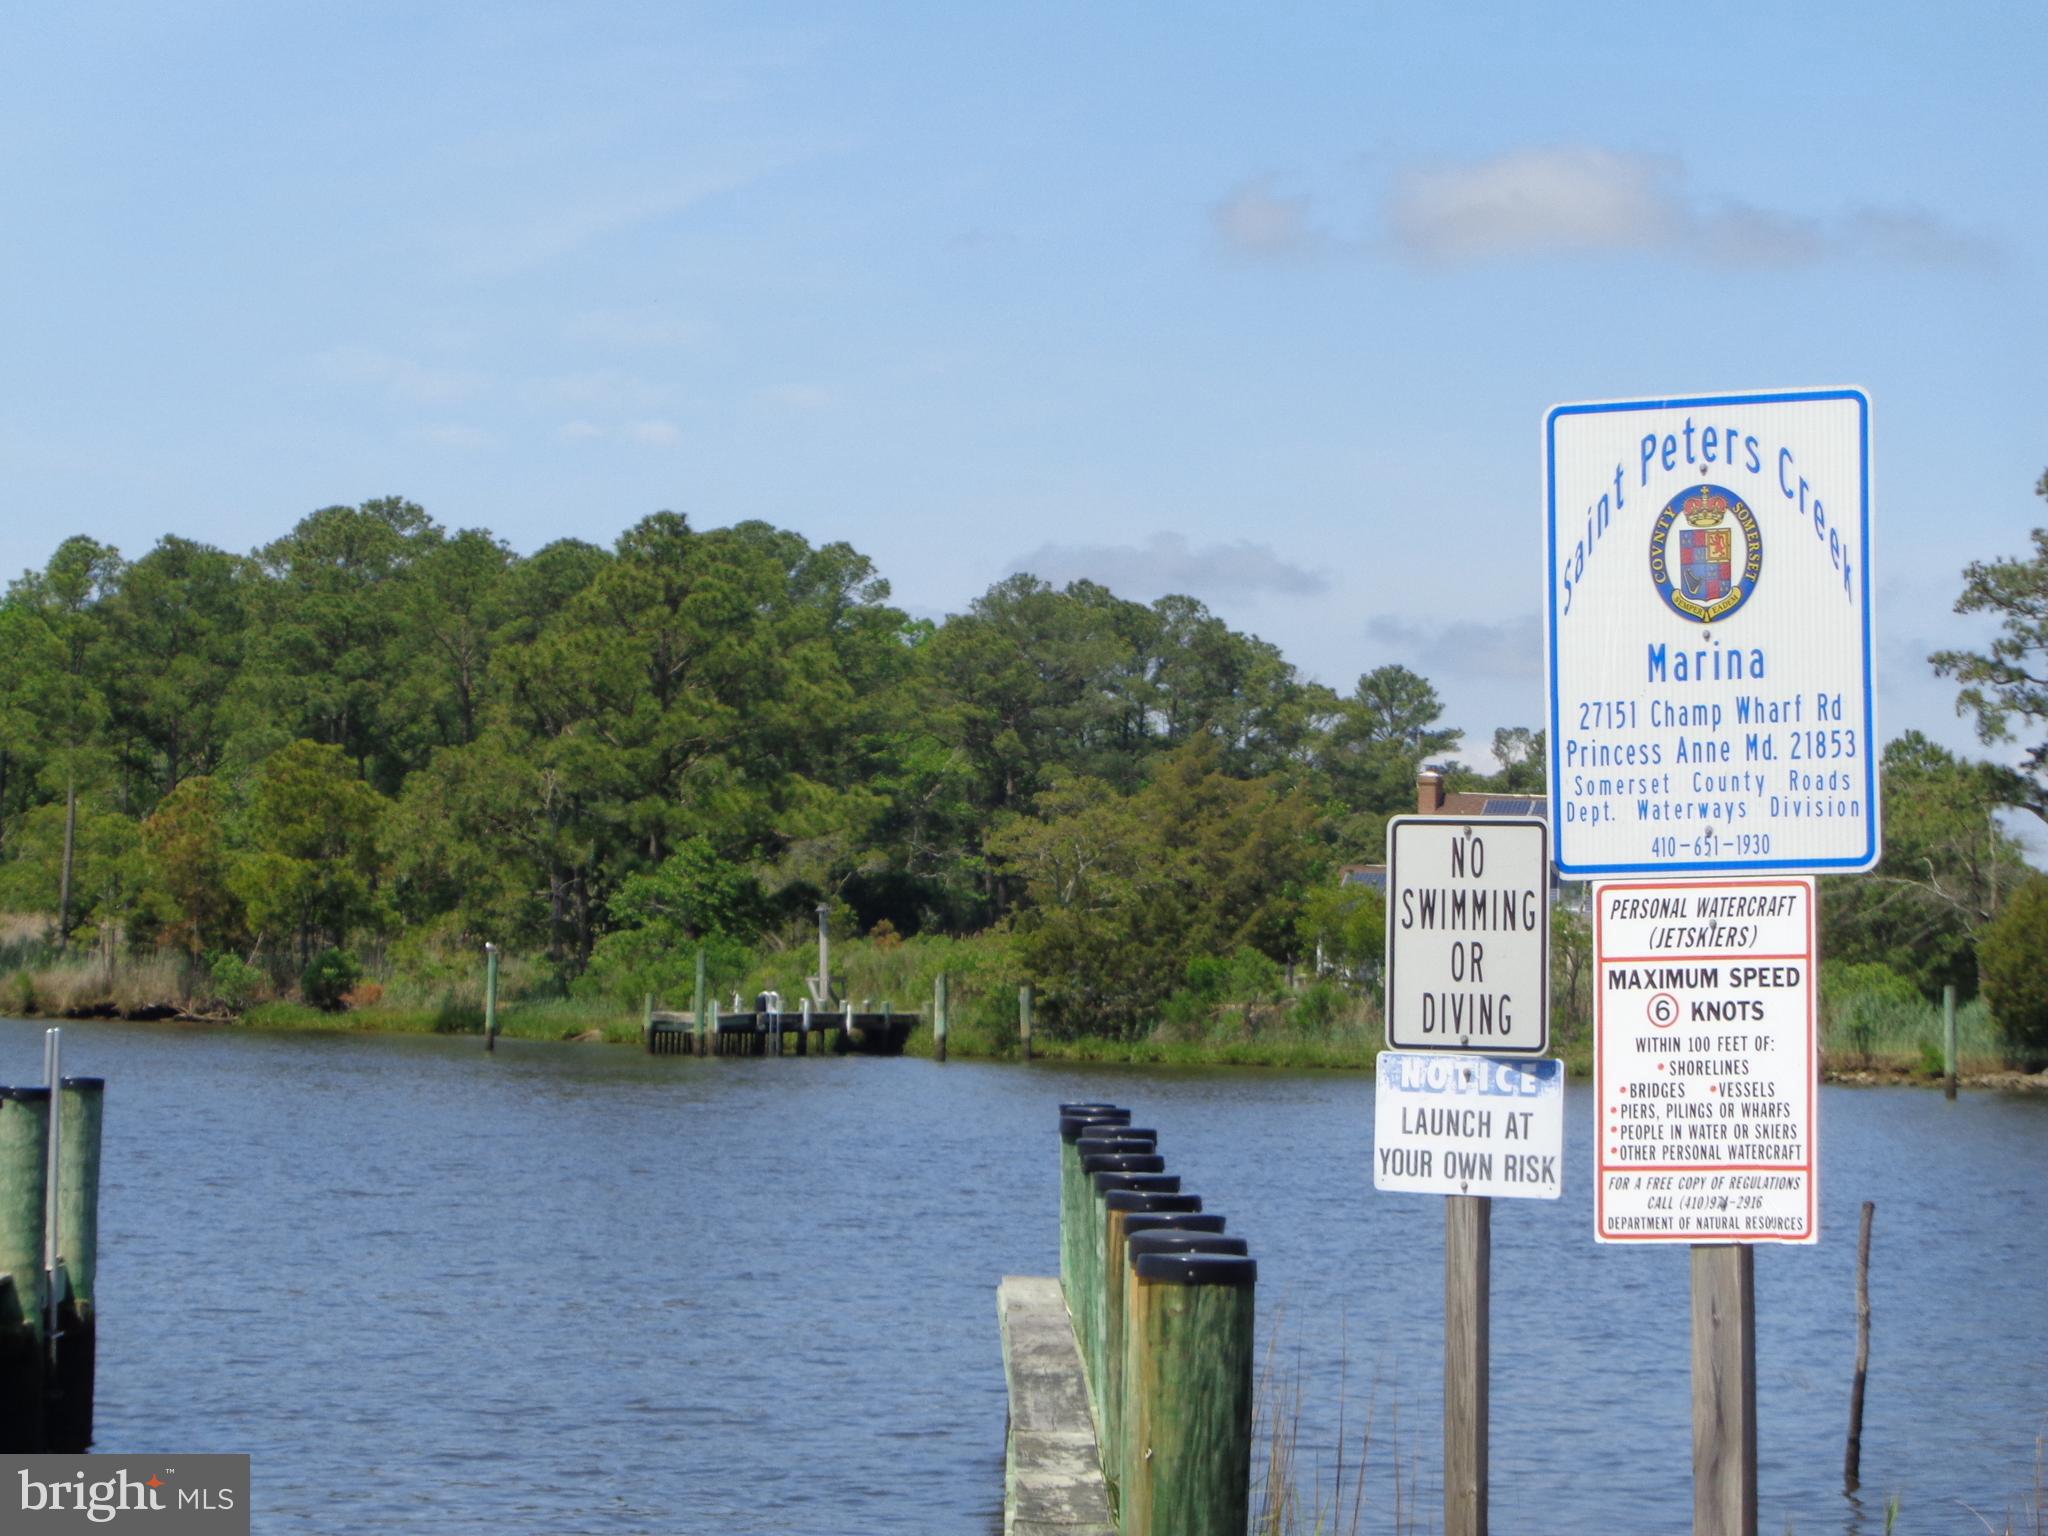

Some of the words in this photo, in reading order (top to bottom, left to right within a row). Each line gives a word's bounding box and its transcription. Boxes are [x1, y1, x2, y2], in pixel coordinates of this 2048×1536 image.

[1563, 461, 1625, 616] Saint
[1641, 416, 1761, 487] Peters
[1778, 447, 1852, 605] Creek
[1733, 502, 1760, 582] SOMERSET
[1648, 640, 1765, 683] Marina
[1579, 701, 1637, 730] 27151
[1651, 699, 1722, 732] Champ
[1736, 694, 1802, 725] Wharf
[1817, 693, 1842, 721] Rd
[1568, 739, 1662, 767] Princess
[1677, 736, 1730, 764] Anne
[1746, 732, 1778, 761] Md.
[1790, 729, 1856, 760] 21853
[1575, 773, 1670, 797] Somerset
[1693, 772, 1765, 797] County
[1789, 769, 1851, 791] Roads
[1567, 802, 1616, 827] Dept.
[1637, 798, 1747, 823] Waterways
[1771, 796, 1860, 817] Division
[1452, 836, 1484, 879] NO
[1651, 833, 1771, 858] 410-651-1930
[1401, 888, 1536, 932] SWIMMING
[1610, 897, 1687, 920] PERSONAL
[1696, 895, 1796, 918] WATERCRAFT
[1649, 924, 1758, 950] (JETSKIERS)
[1451, 941, 1484, 983] OR
[1608, 968, 1718, 990] MAXIMUM
[1729, 967, 1800, 988] SPEED
[1422, 992, 1512, 1036] DIVING
[1655, 1000, 1670, 1021] 6
[1691, 1000, 1764, 1022] KNOTS
[1636, 1037, 1681, 1053] WITHIN
[1688, 1037, 1710, 1052] 100
[1717, 1036, 1748, 1052] FEET
[1755, 1036, 1775, 1052] OF:
[1399, 1059, 1537, 1097] NOTICE
[1669, 1060, 1749, 1076] SHORELINES
[1630, 1082, 1686, 1098] BRIDGES
[1719, 1082, 1775, 1097] VESSELS
[1402, 1106, 1492, 1139] LAUNCH
[1504, 1111, 1534, 1141] AT
[1621, 1104, 1660, 1120] PIERS,
[1667, 1103, 1713, 1119] PILINGS
[1719, 1102, 1735, 1118] OR
[1741, 1102, 1790, 1118] WHARFS
[1621, 1124, 1664, 1140] PEOPLE
[1671, 1124, 1682, 1140] IN
[1688, 1124, 1727, 1140] WATER
[1734, 1124, 1749, 1139] OR
[1755, 1123, 1798, 1139] SKIERS
[1379, 1147, 1432, 1179] YOUR
[1443, 1150, 1493, 1182] OWN
[1504, 1154, 1555, 1184] RISK
[1620, 1145, 1656, 1161] OTHER
[1662, 1145, 1722, 1161] PERSONAL
[1728, 1144, 1802, 1160] WATERCRAFT
[1608, 1177, 1630, 1190] FOR
[1634, 1177, 1642, 1190] A
[1647, 1177, 1674, 1190] FREE
[1678, 1177, 1705, 1190] COPY
[1710, 1176, 1724, 1190] OF
[1729, 1176, 1801, 1190] REGULATIONS
[1647, 1196, 1674, 1210] CALL
[1608, 1216, 1674, 1230] DEPARTMENT
[1679, 1216, 1692, 1230] OF
[1696, 1216, 1740, 1230] NATURAL
[1745, 1216, 1803, 1231] RESOURCES
